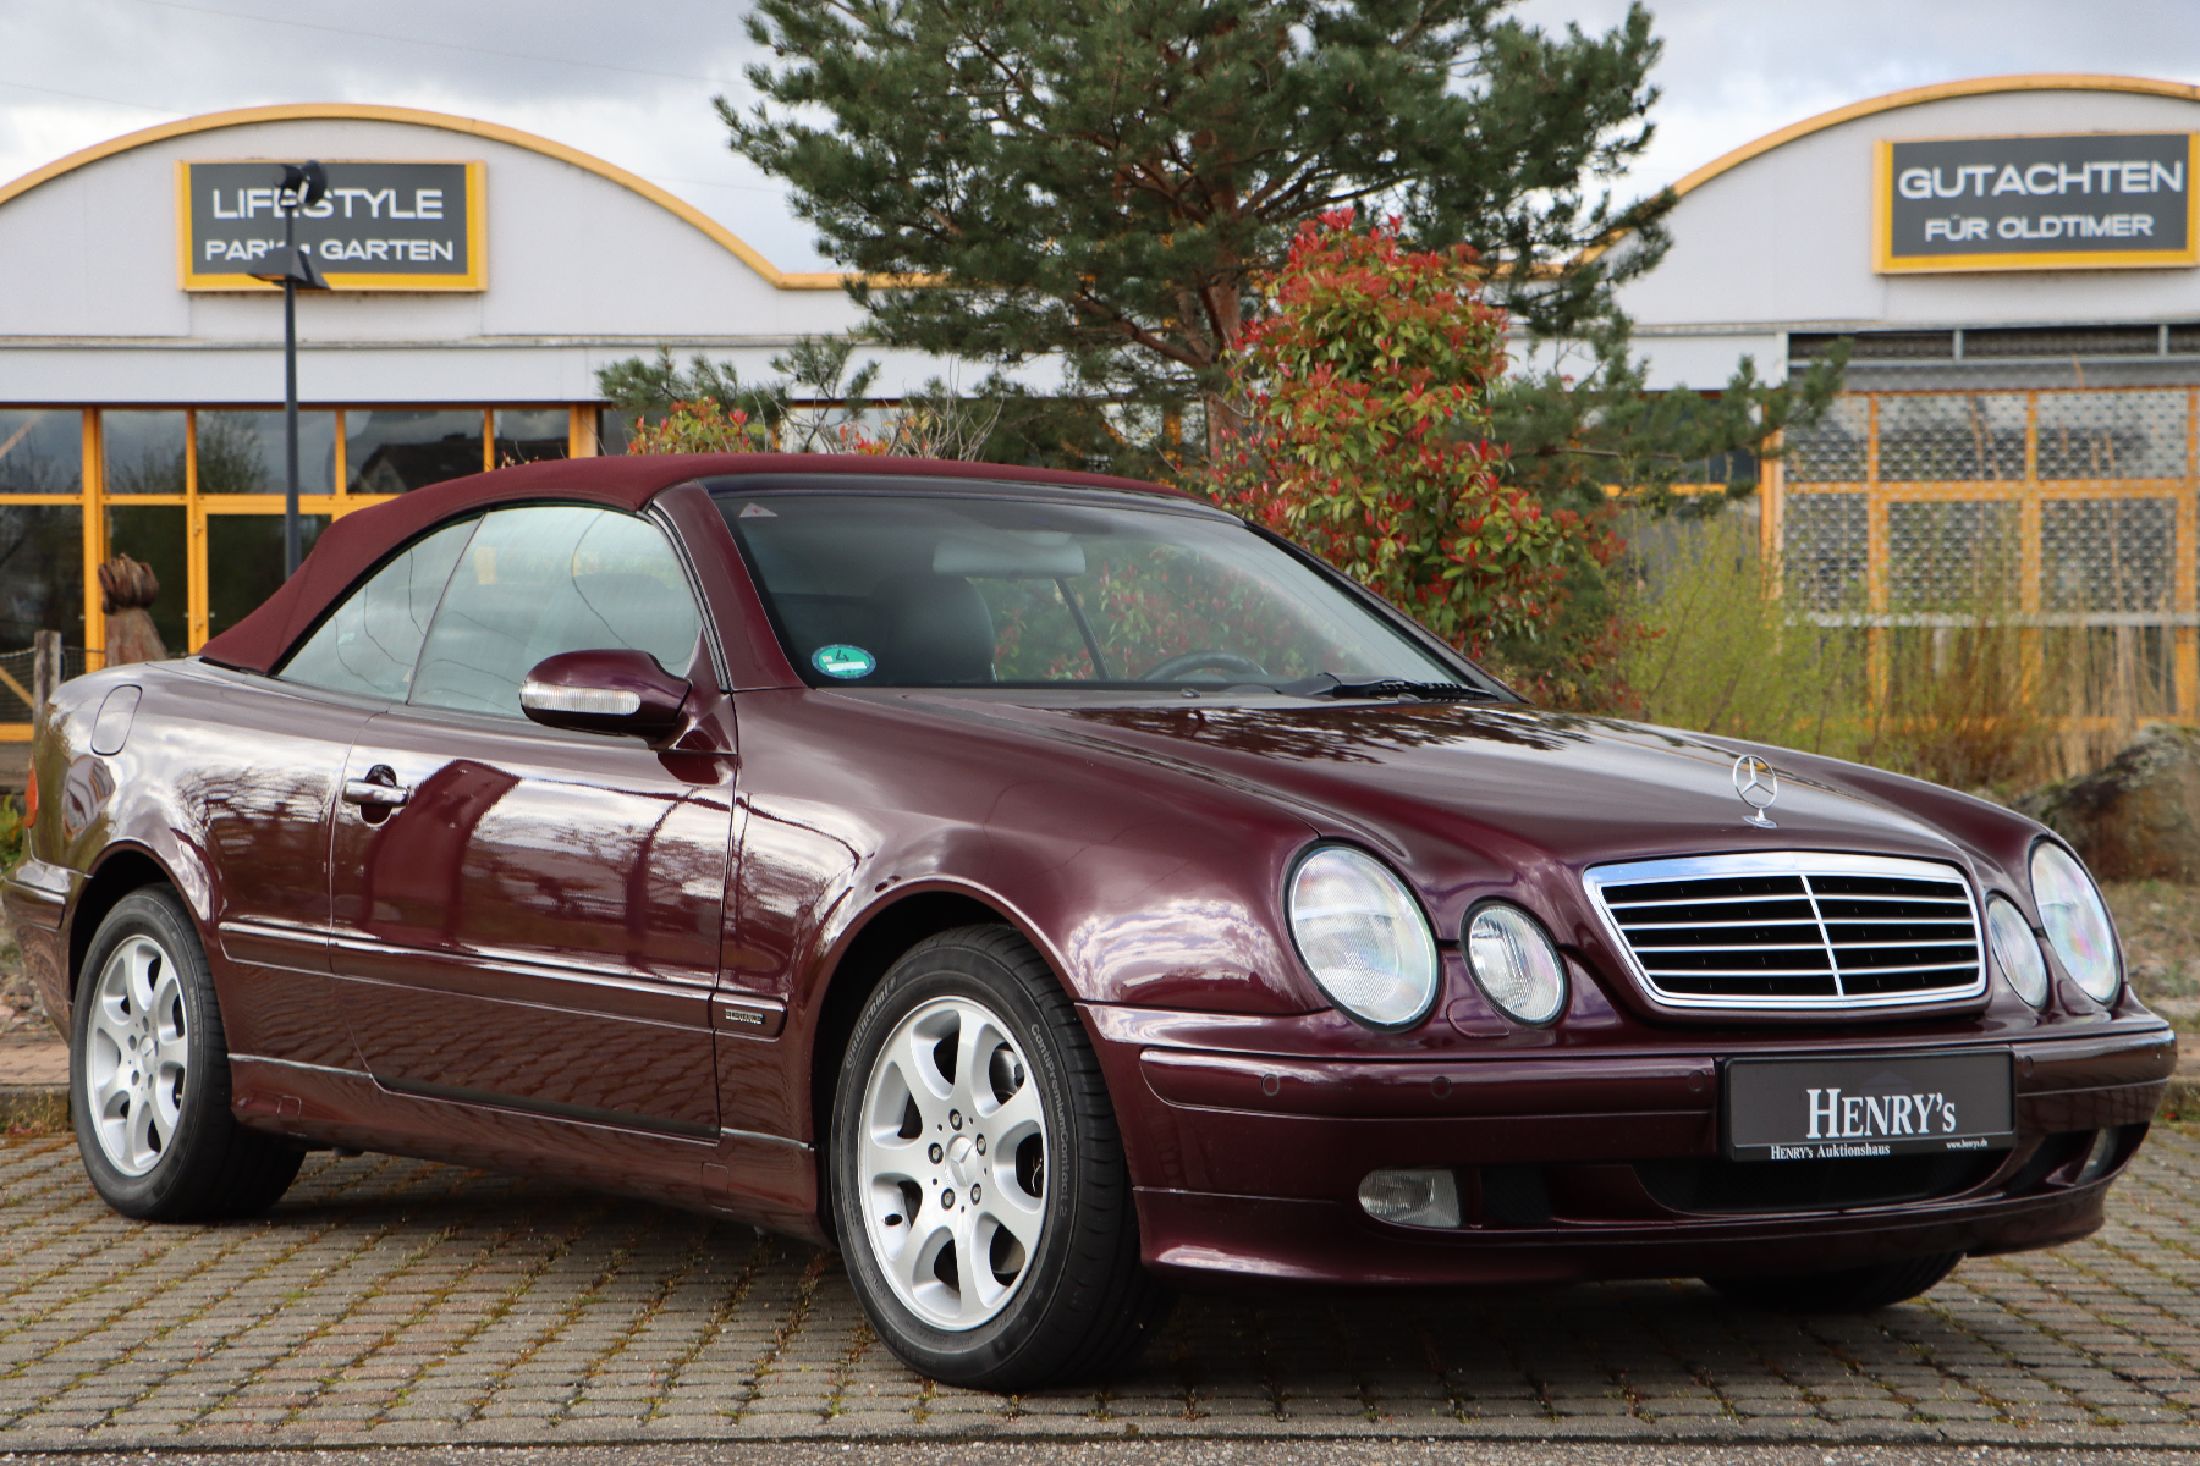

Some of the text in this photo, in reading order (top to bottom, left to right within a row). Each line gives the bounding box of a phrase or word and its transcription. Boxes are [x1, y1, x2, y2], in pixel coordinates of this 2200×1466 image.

[1898, 160, 2184, 199] GUTACHTEN
[1924, 213, 2154, 242] FÜR OLDTIMER
[319, 238, 453, 261] GARTEN
[1816, 1142, 1891, 1158] Auktionshaus
